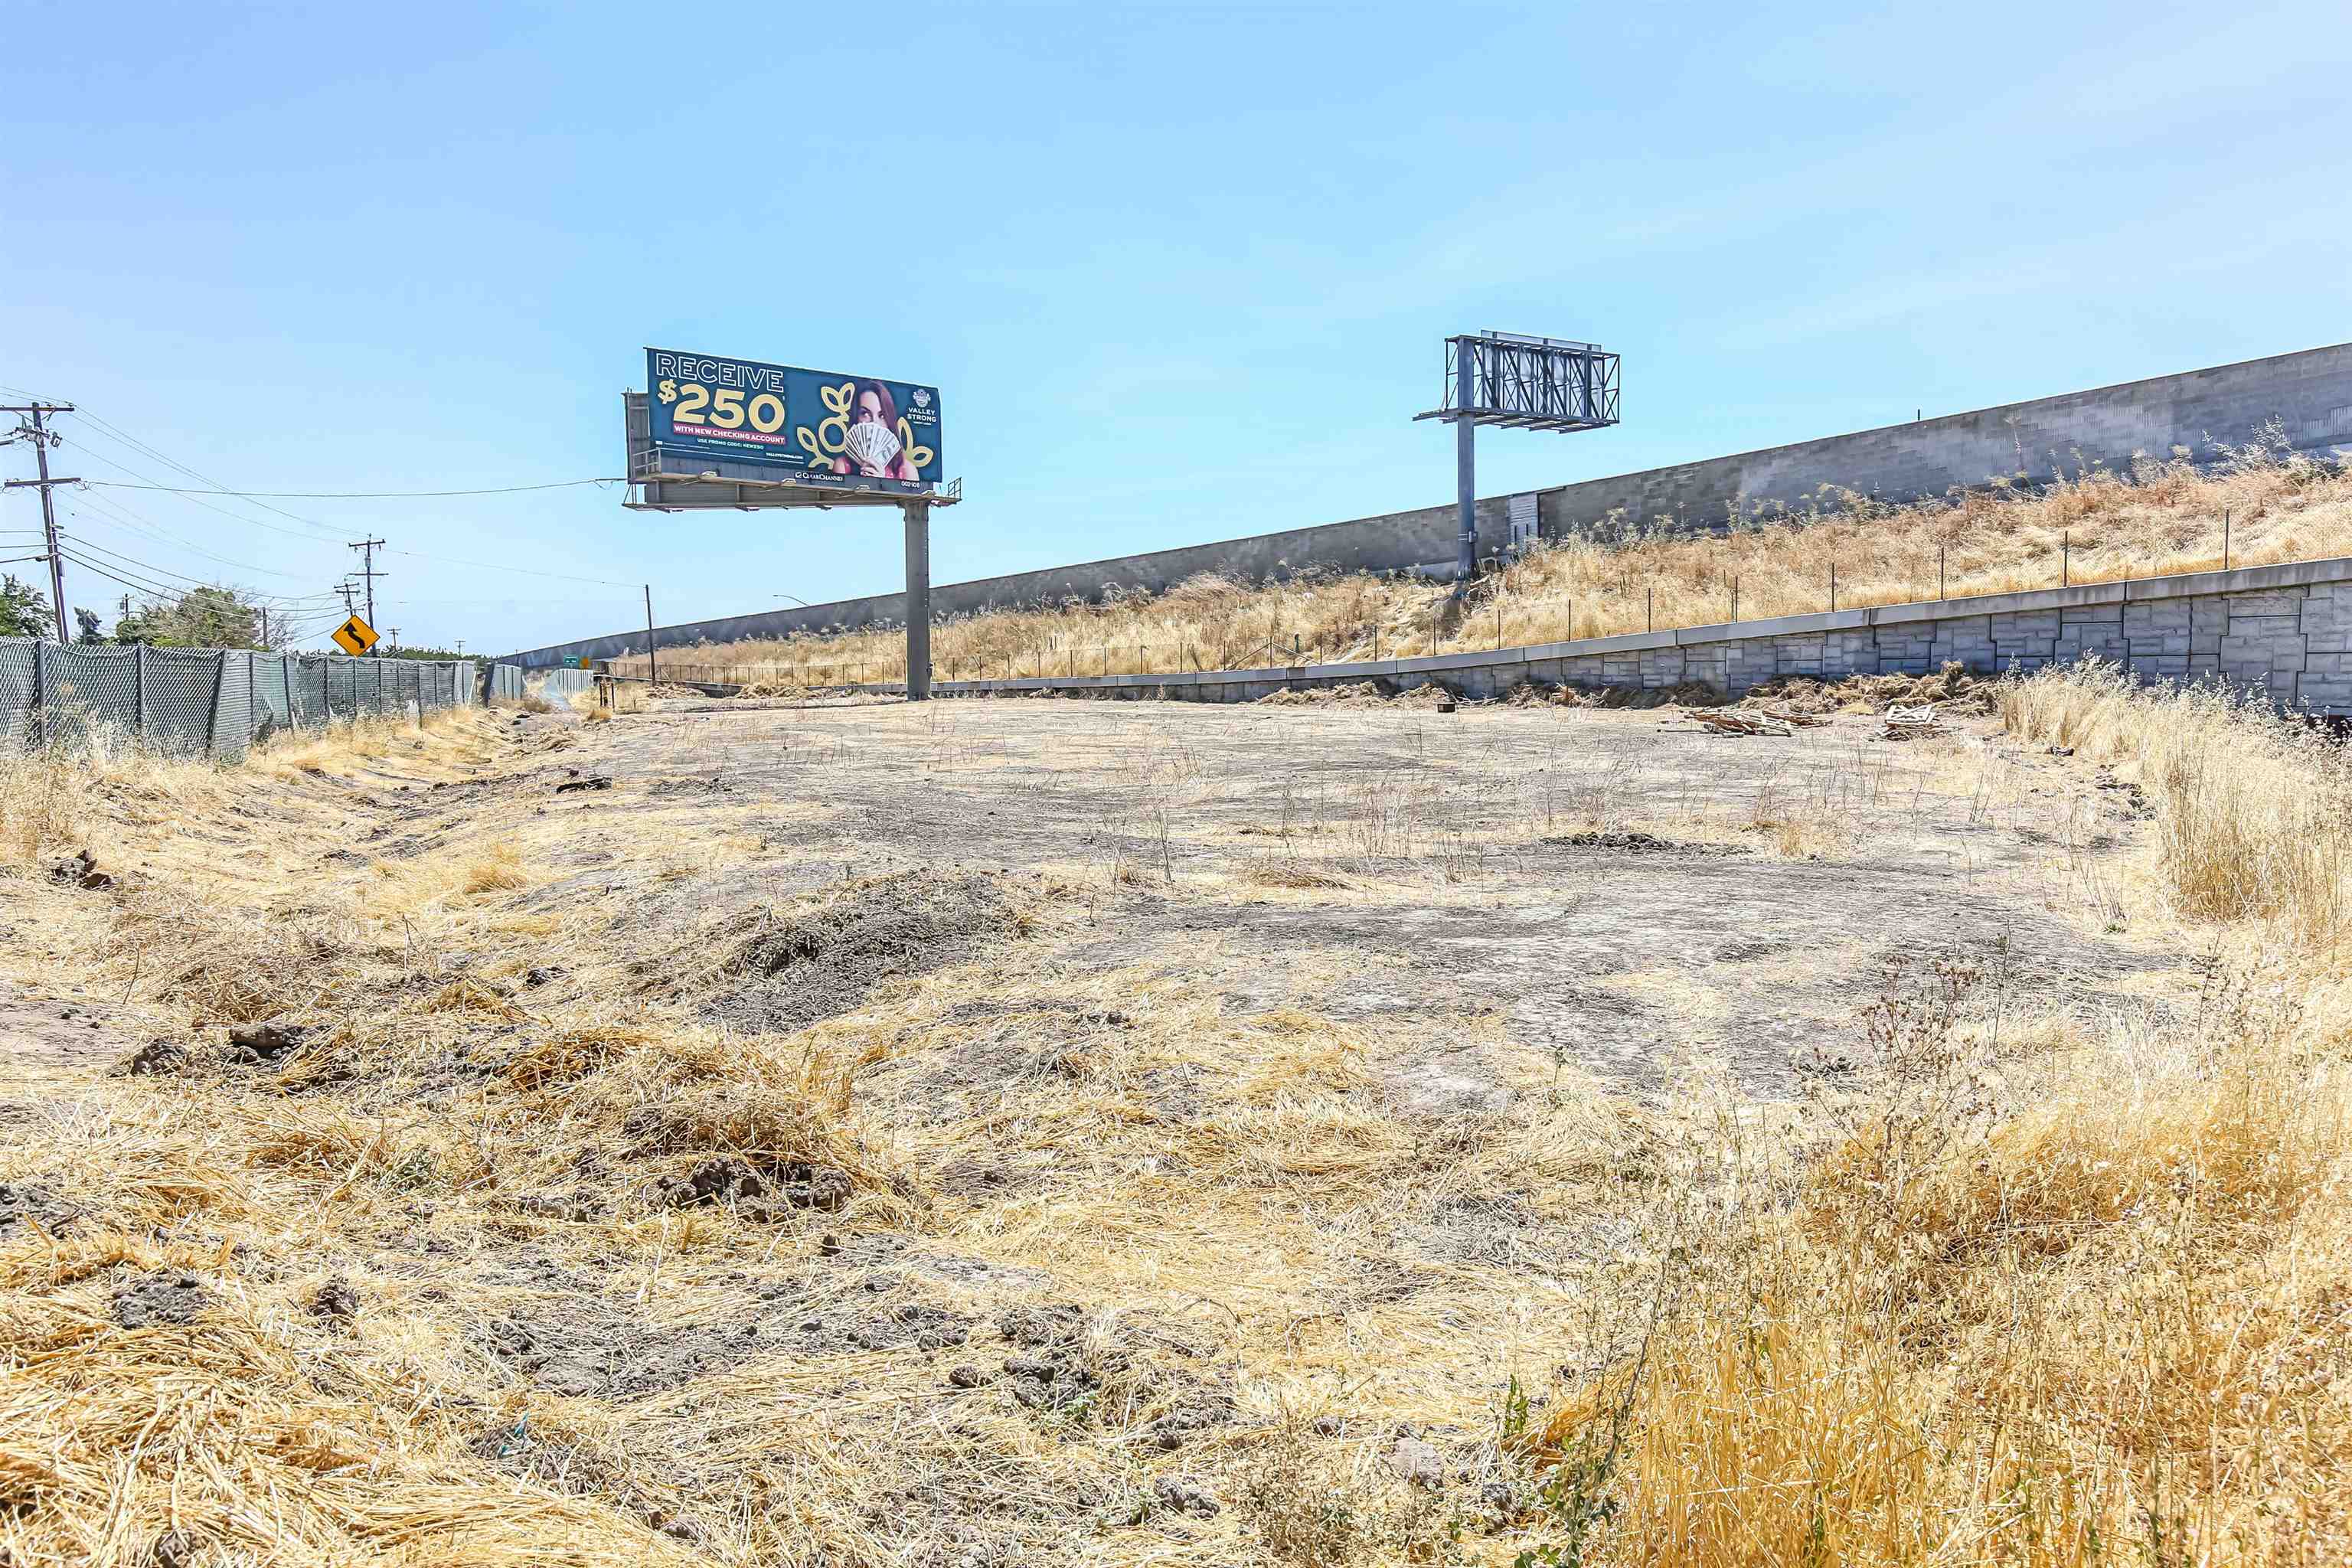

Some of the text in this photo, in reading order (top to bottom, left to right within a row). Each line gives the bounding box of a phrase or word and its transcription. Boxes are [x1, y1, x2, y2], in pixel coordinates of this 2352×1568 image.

[656, 353, 784, 392] RECEIVE
[908, 407, 935, 416] VALLEY
[906, 413, 936, 423] STRONG
[713, 430, 750, 439] CHECKING
[751, 434, 786, 443] ACCOUNT
